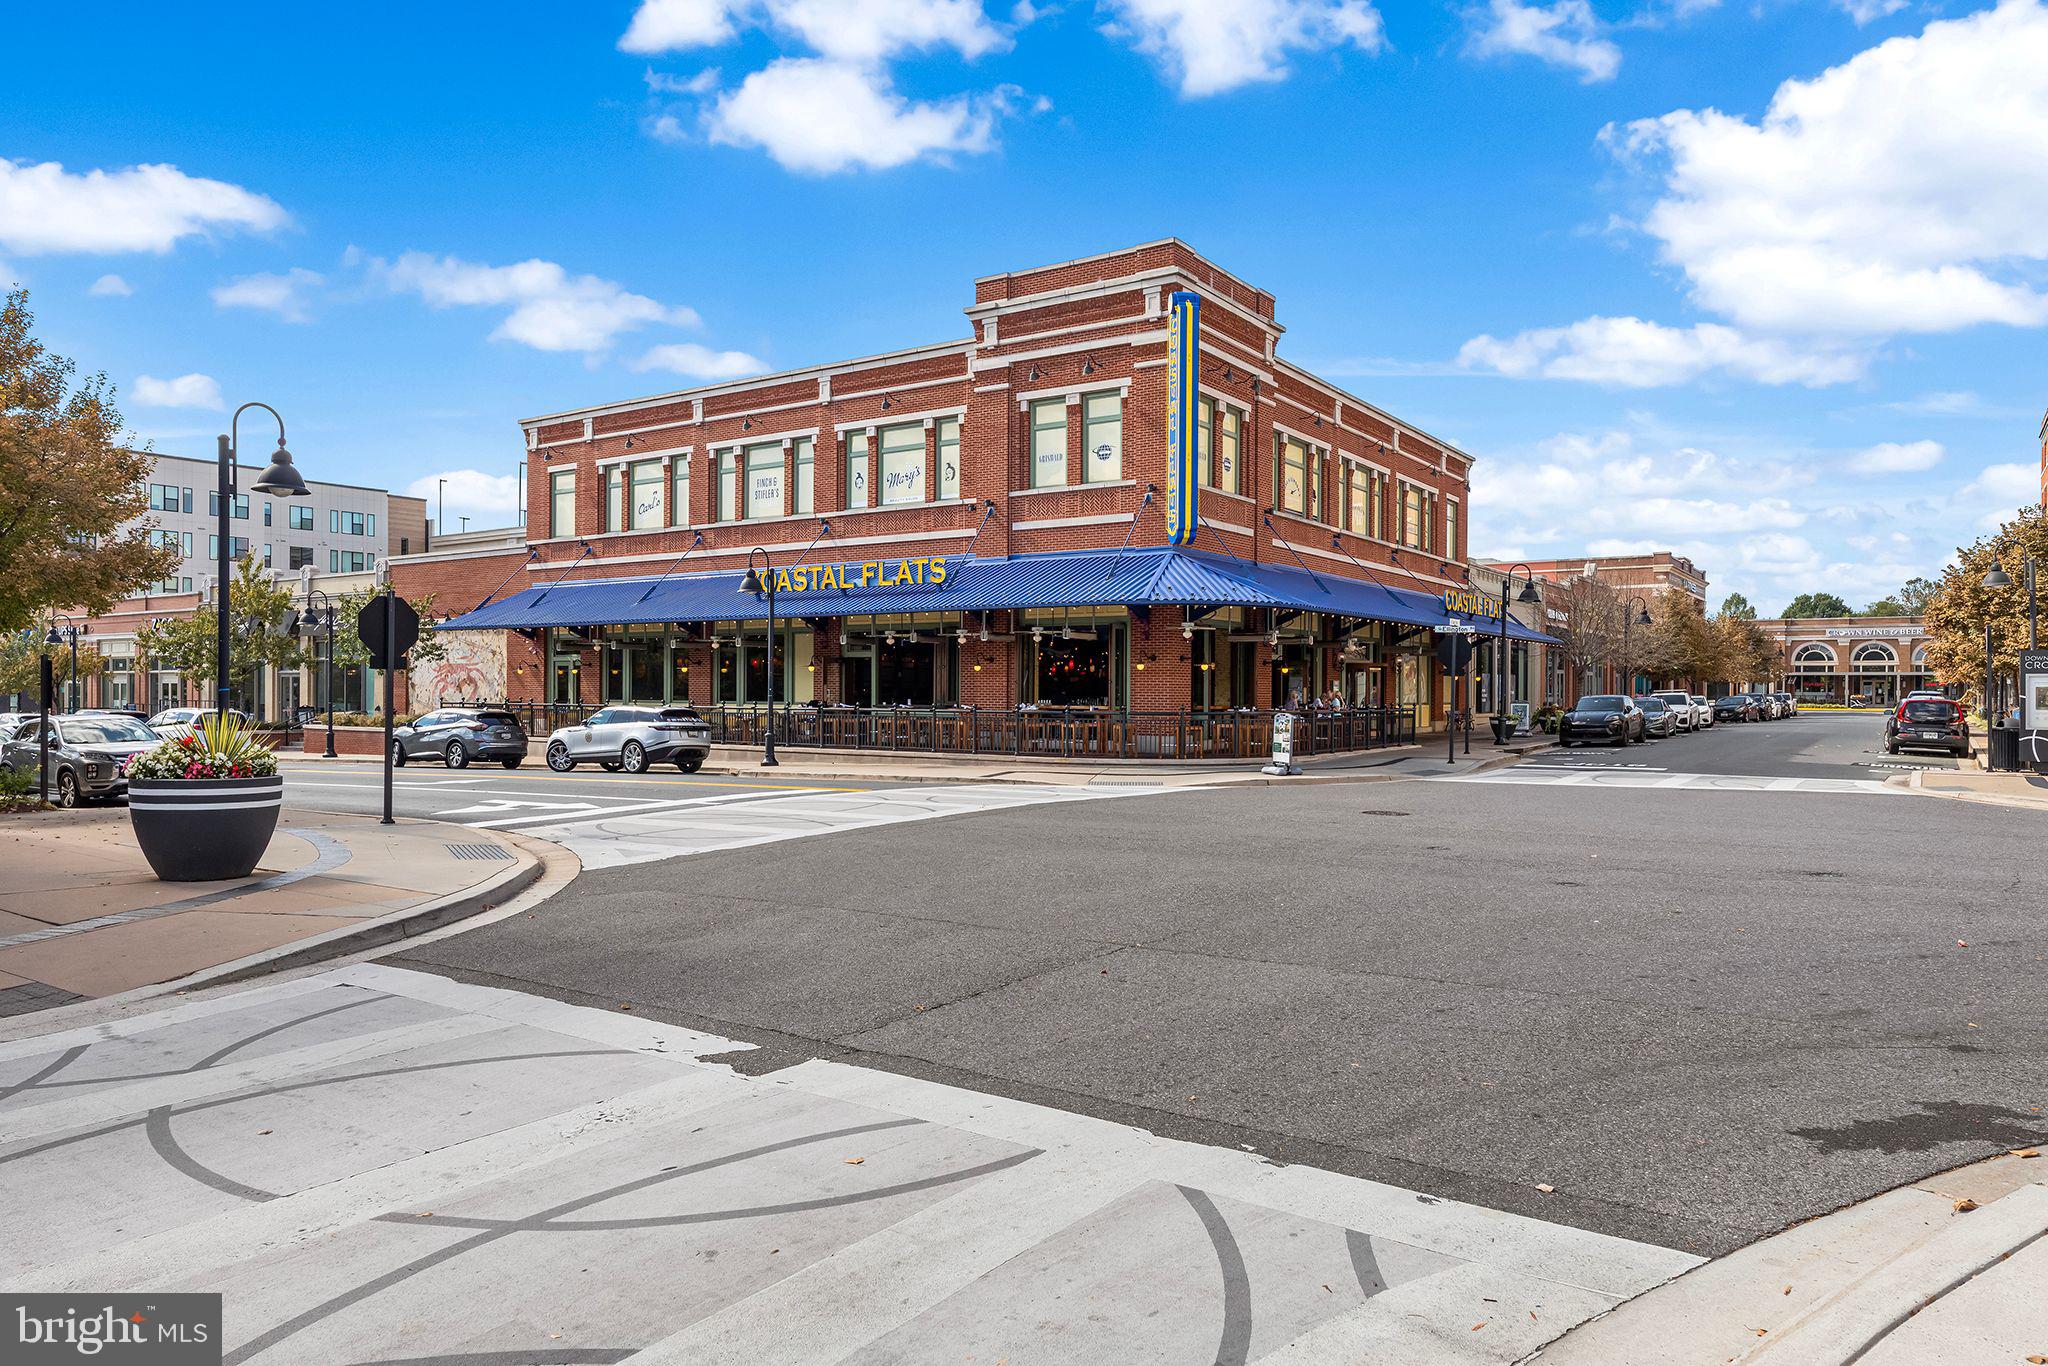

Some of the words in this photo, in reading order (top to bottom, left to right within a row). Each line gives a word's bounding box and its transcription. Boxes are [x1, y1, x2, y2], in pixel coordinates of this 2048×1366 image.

[886, 465, 921, 489] Mary's
[638, 497, 661, 515] Carl's
[756, 564, 854, 593] OASTAL
[862, 557, 946, 588] FLATS
[1445, 590, 1482, 616] COASTAL
[1483, 597, 1504, 619] FLAT
